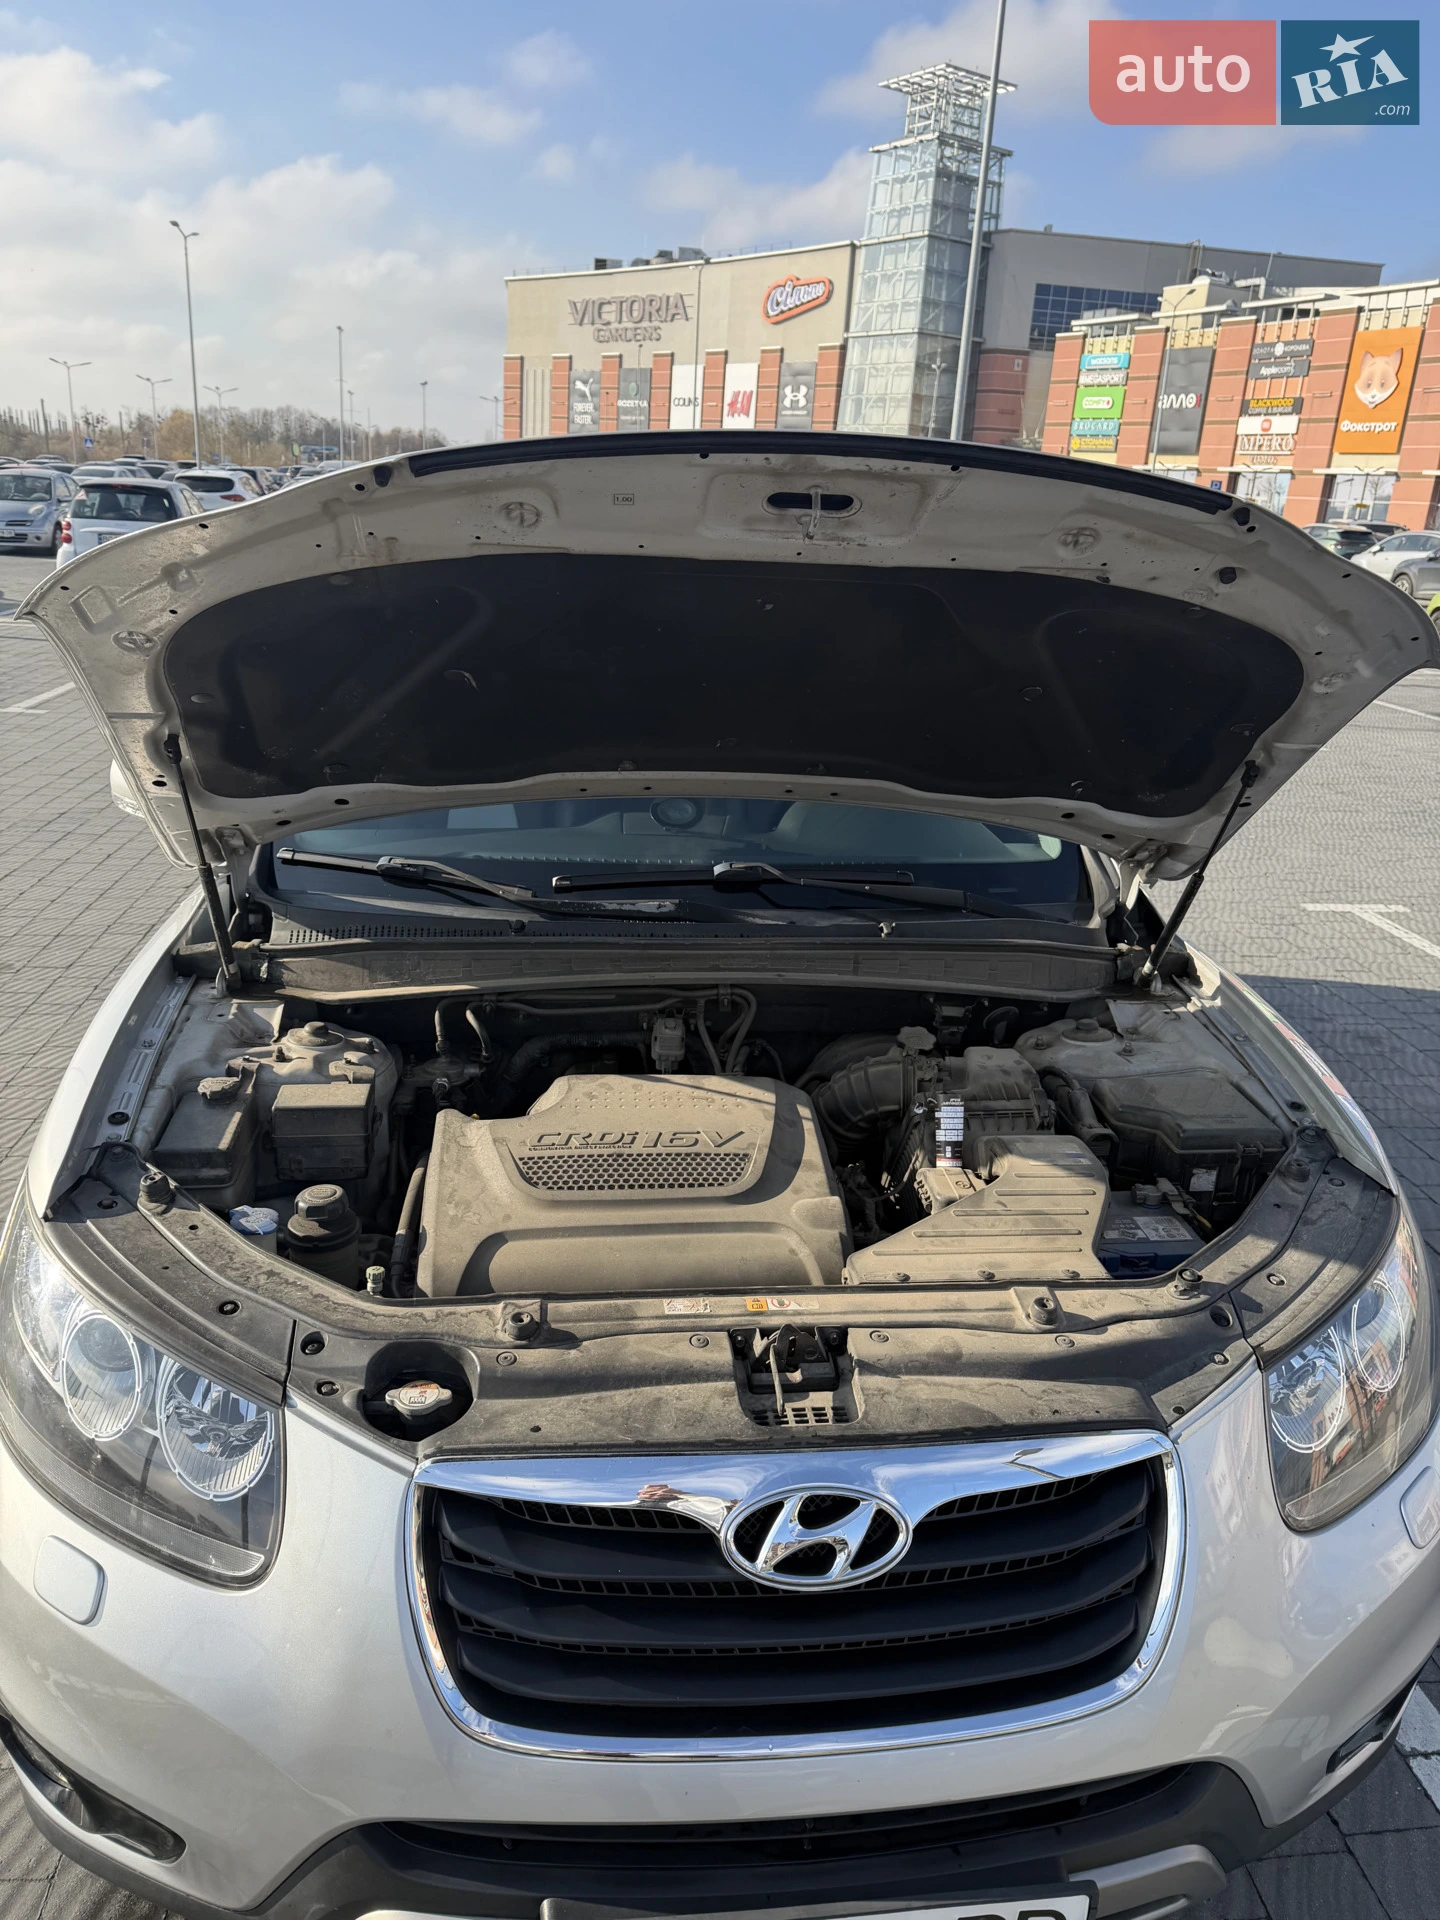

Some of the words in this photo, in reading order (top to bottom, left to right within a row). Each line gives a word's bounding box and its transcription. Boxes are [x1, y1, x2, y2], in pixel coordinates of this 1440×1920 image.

[767, 280, 825, 316] Сільпо
[568, 292, 688, 326] VICTORIA
[593, 326, 662, 343] GARDENS
[727, 391, 753, 418] H&M
[1084, 399, 1106, 407] COMFY
[1249, 398, 1294, 408] BLACKWOOD
[1073, 421, 1115, 431] BROCARD
[1340, 420, 1398, 434] Фокстрот
[1237, 434, 1295, 452] IMPERO
